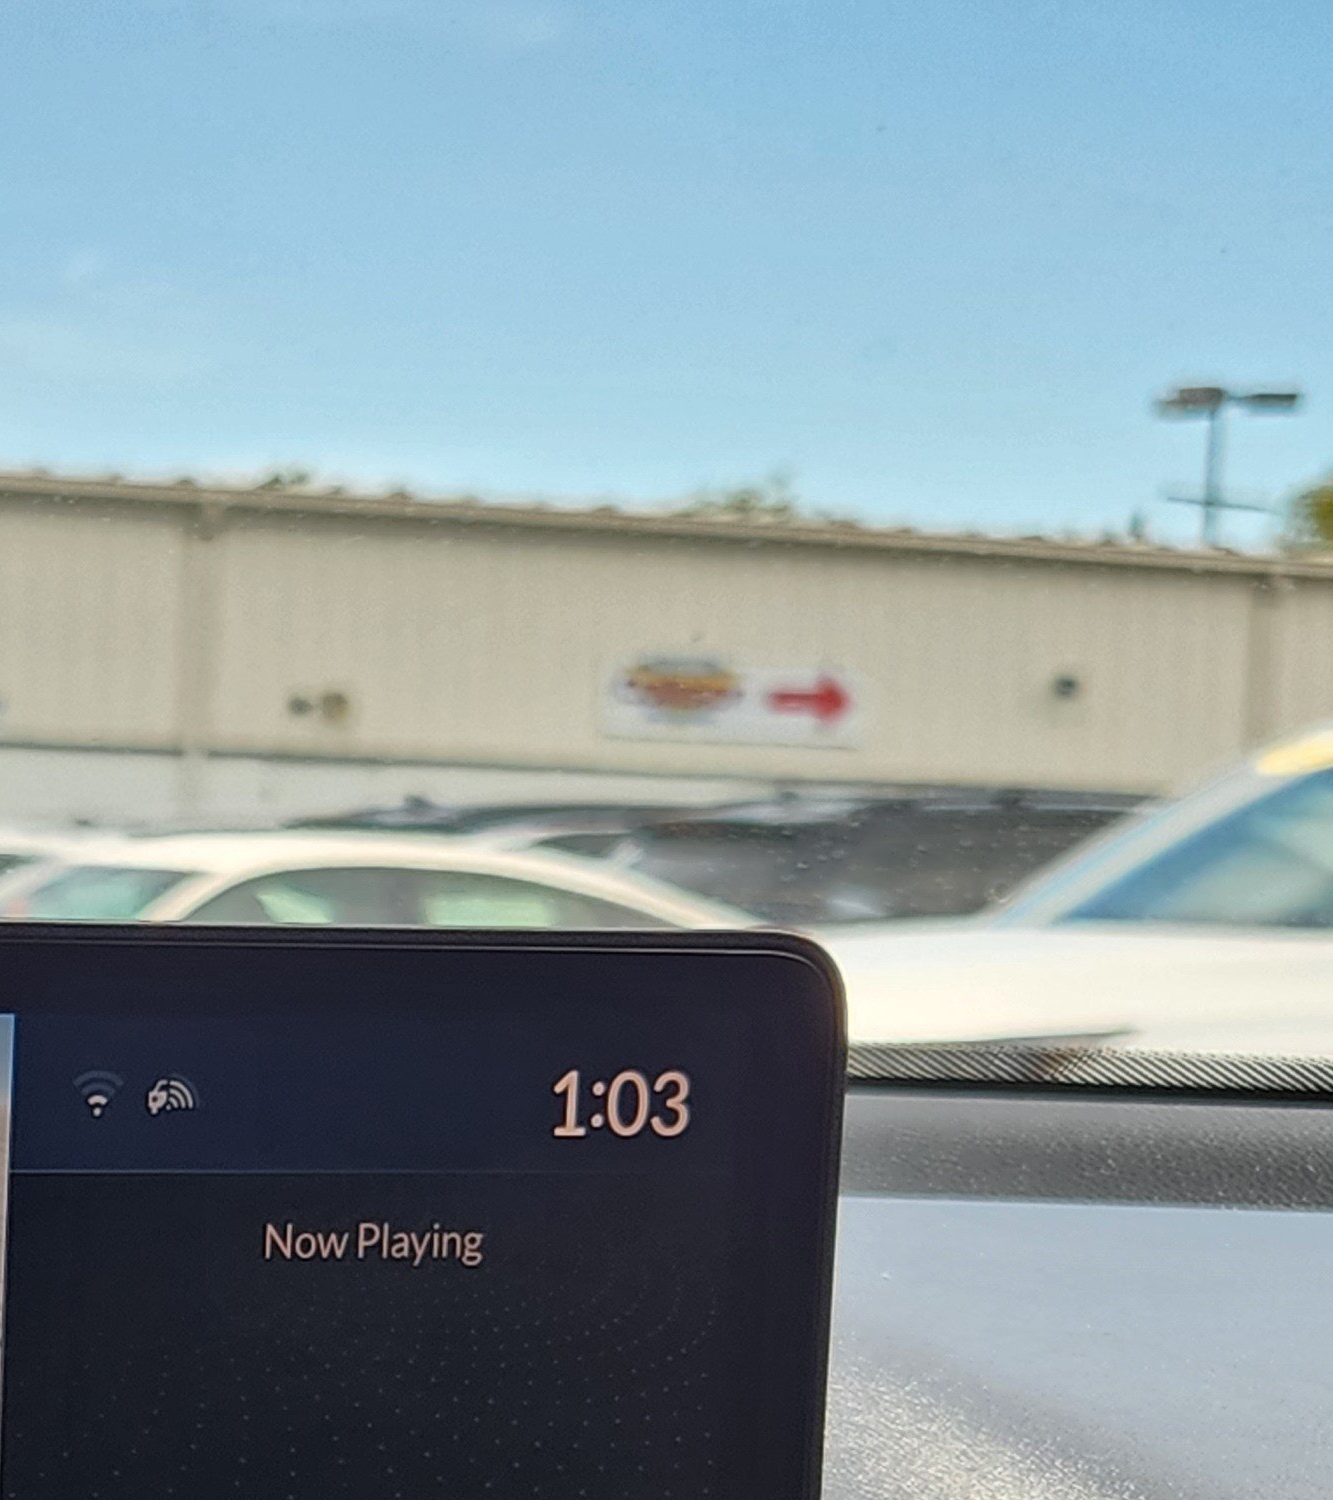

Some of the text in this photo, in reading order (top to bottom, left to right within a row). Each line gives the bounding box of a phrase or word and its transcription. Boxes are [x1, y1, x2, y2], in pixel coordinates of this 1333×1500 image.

[552, 1069, 691, 1138] 1:03
[263, 1222, 485, 1266] Now Playing
